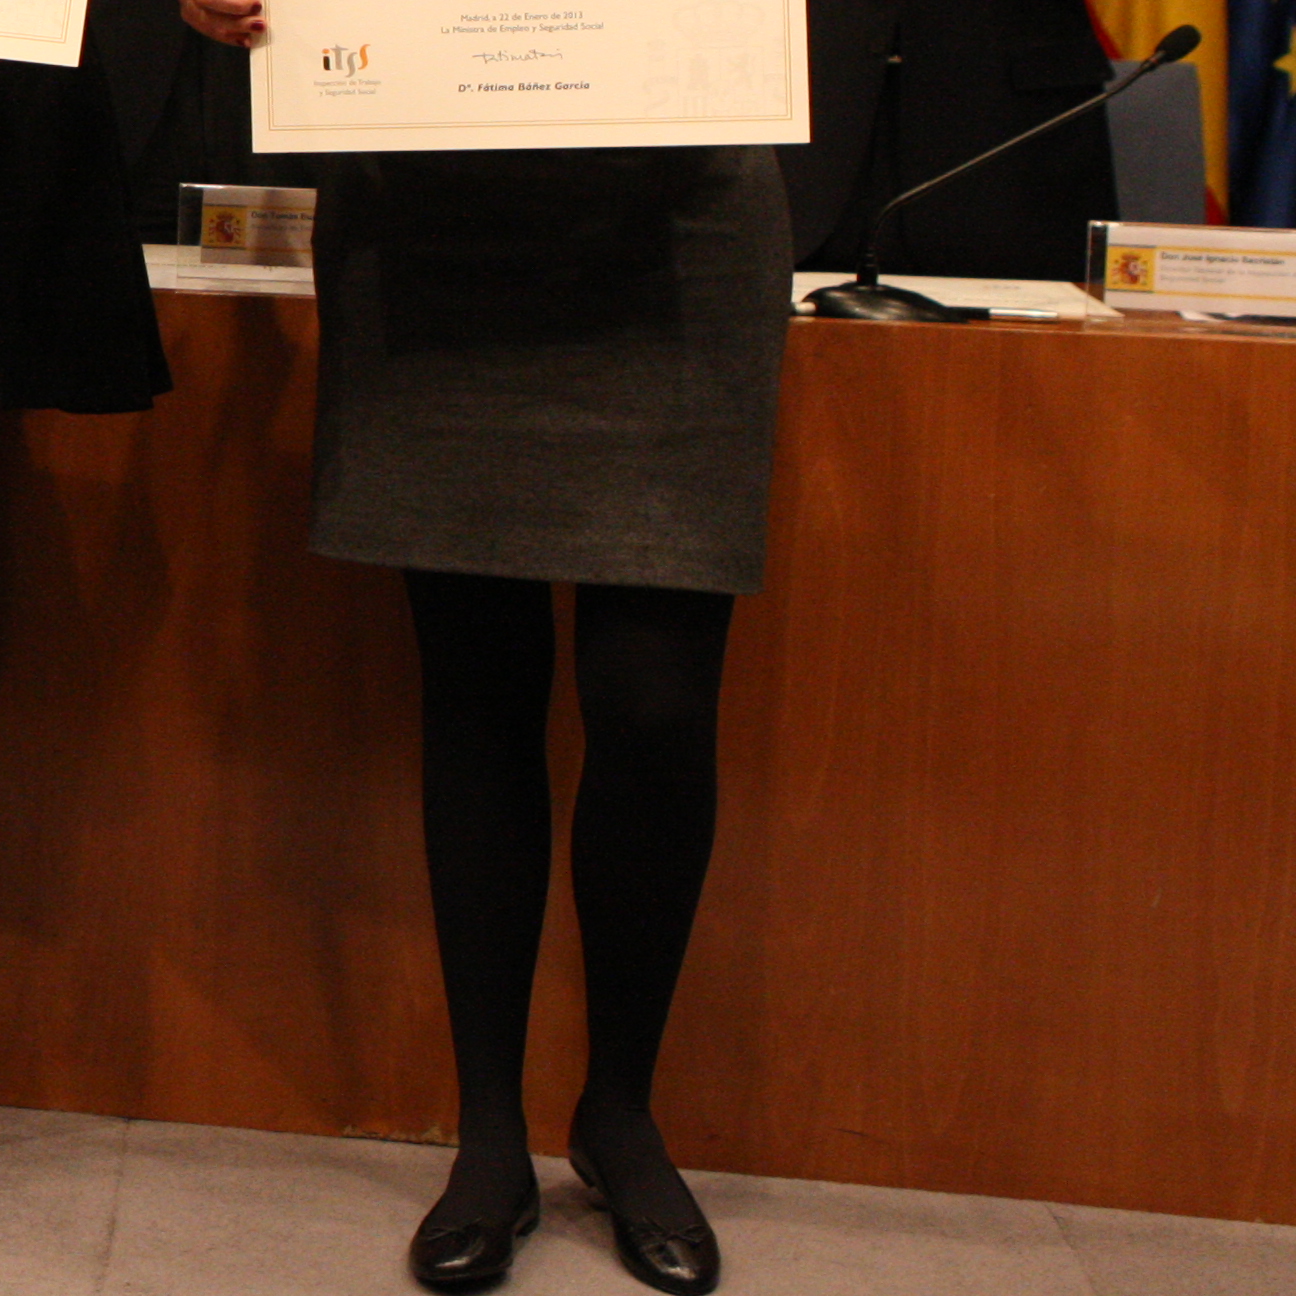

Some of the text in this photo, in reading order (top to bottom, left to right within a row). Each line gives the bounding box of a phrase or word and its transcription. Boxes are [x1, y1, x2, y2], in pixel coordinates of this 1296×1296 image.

[477, 83, 513, 92] Fátima
[517, 82, 550, 91] Báñez
[554, 81, 589, 90] García
